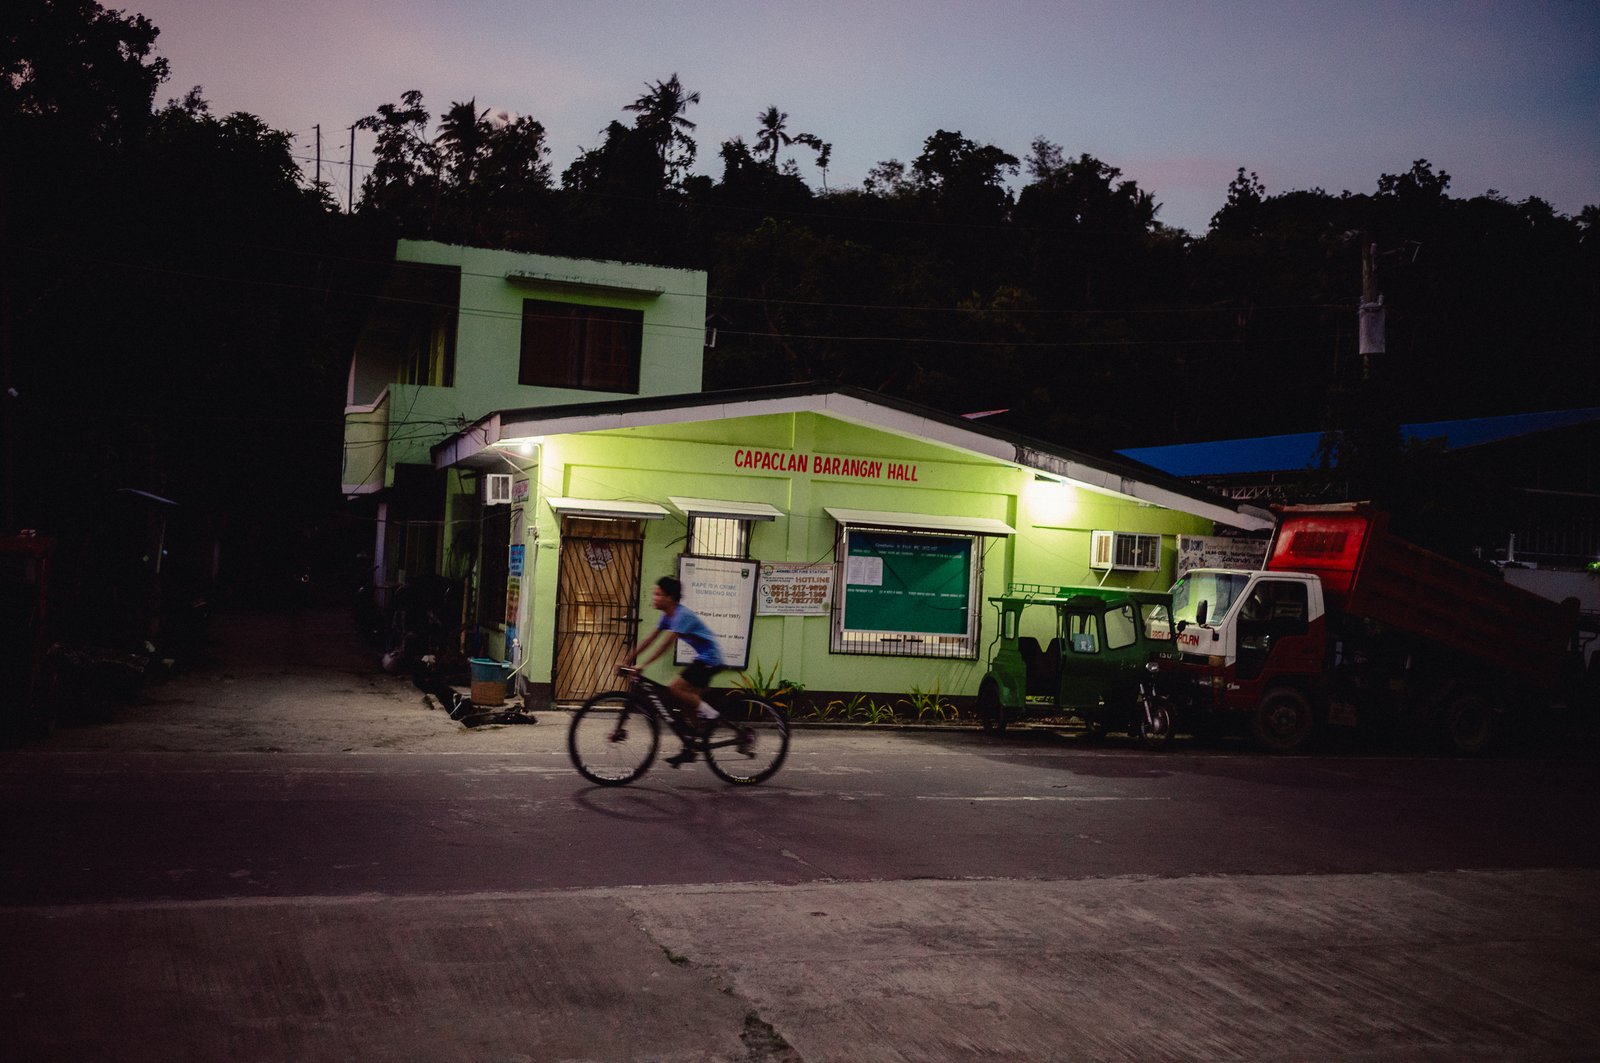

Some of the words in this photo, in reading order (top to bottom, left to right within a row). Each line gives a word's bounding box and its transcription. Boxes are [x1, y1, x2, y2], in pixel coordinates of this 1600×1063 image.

[734, 449, 809, 473] CAPACLAN
[813, 456, 883, 479] BARANGAY
[887, 463, 918, 482] HALL
